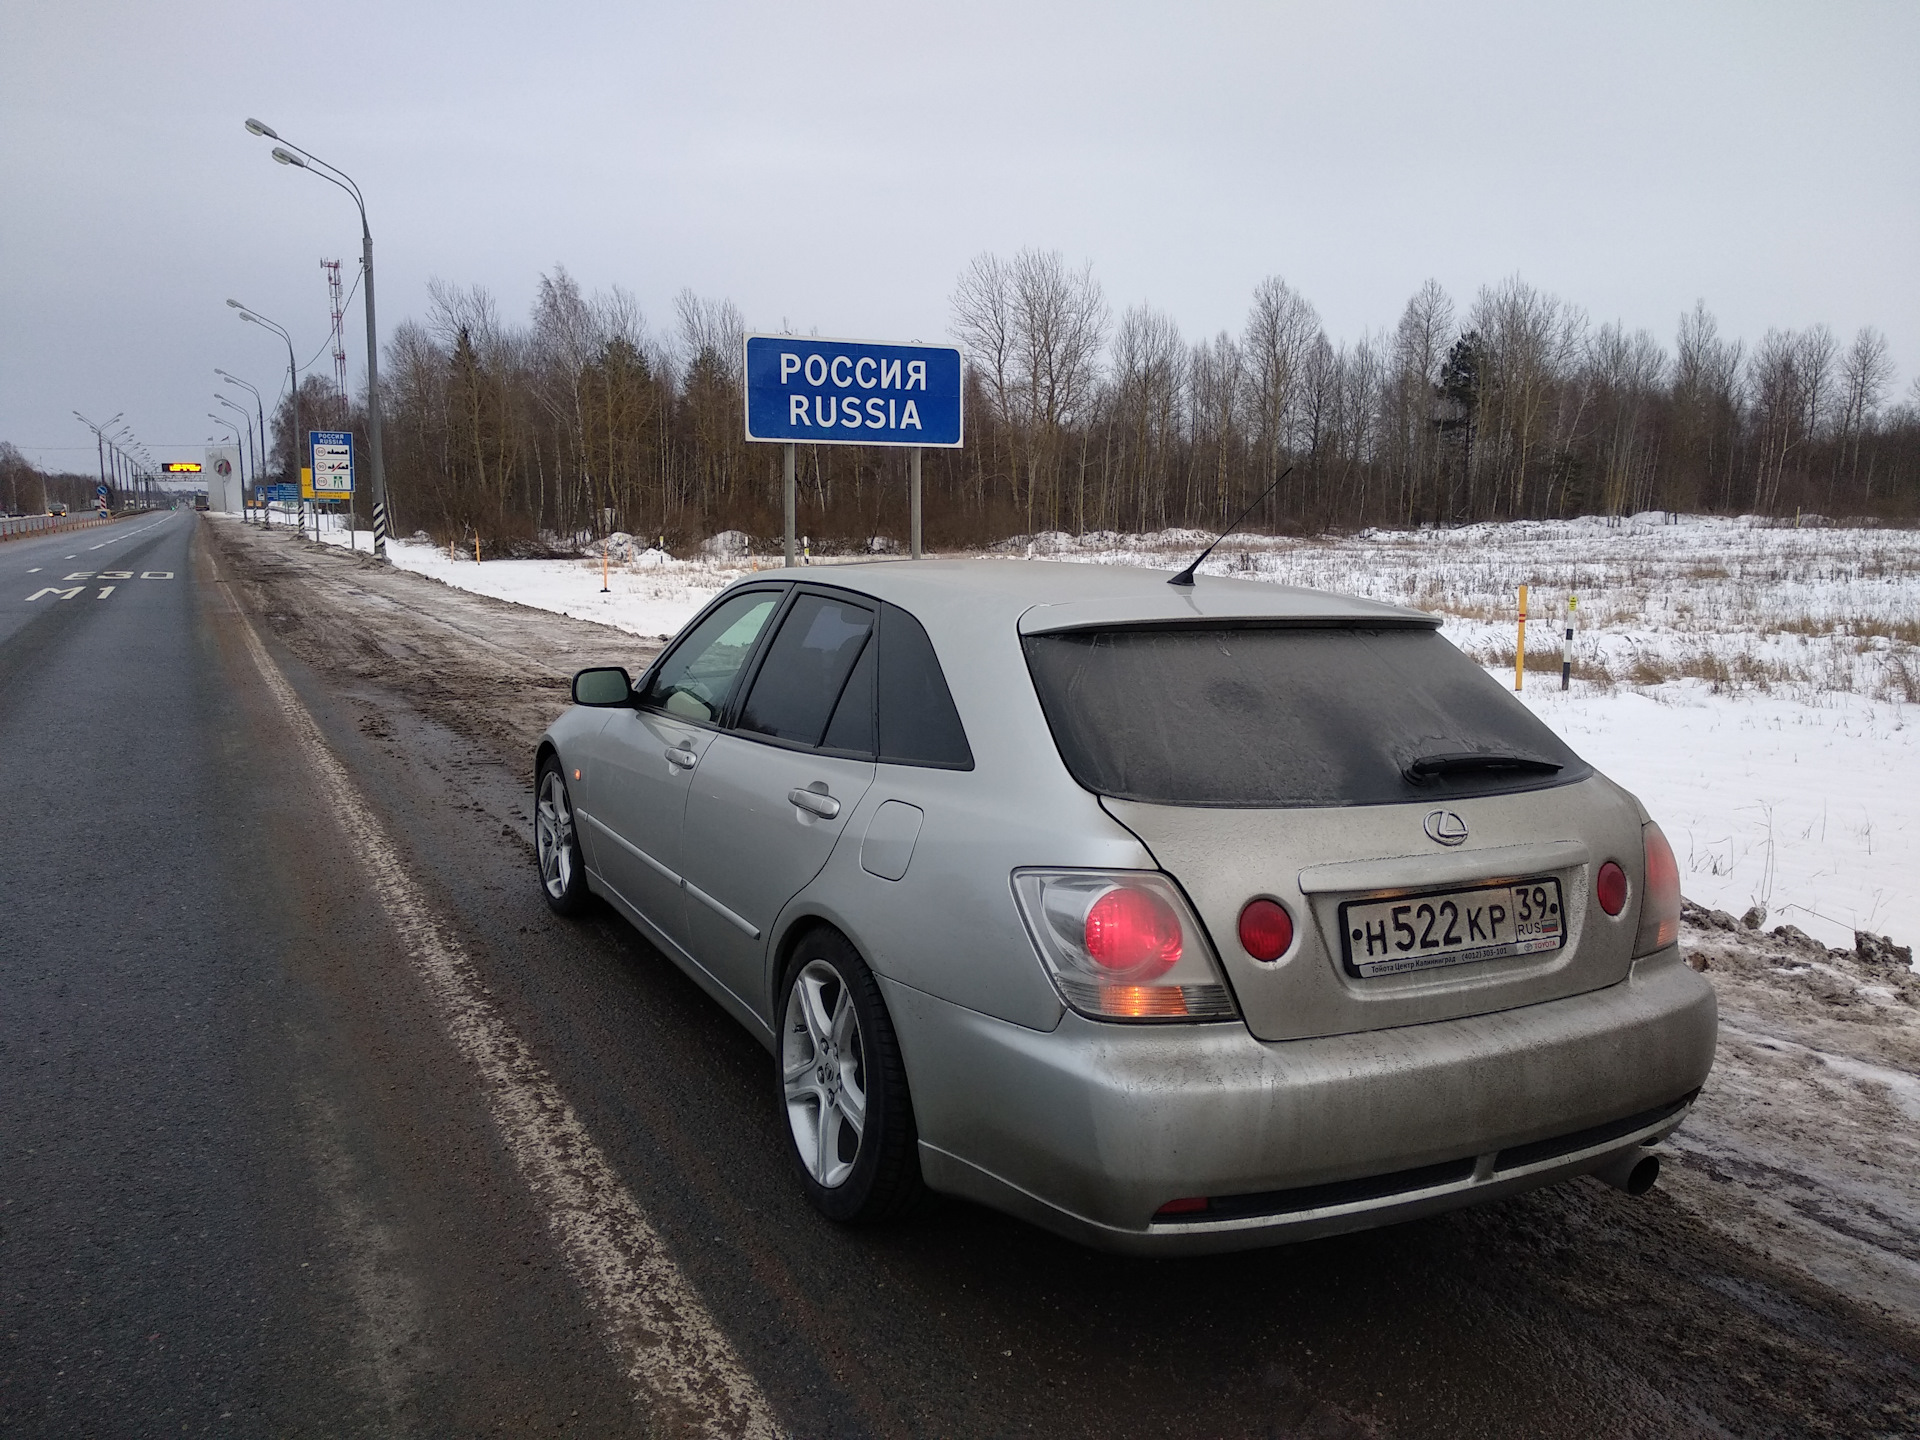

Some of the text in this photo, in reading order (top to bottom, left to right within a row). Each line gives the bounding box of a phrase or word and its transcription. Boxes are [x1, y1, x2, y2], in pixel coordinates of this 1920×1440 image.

[780, 352, 927, 391] РОССИЯ
[789, 394, 923, 431] RUSSIA
[1515, 886, 1548, 922] 39
[1517, 922, 1541, 936] RUS
[1534, 940, 1557, 950] TOYOTA
[1371, 965, 1394, 974] Тойота
[1394, 960, 1415, 972] Центр
[1415, 955, 1457, 968] Калининград
[1461, 950, 1482, 962] (4012)
